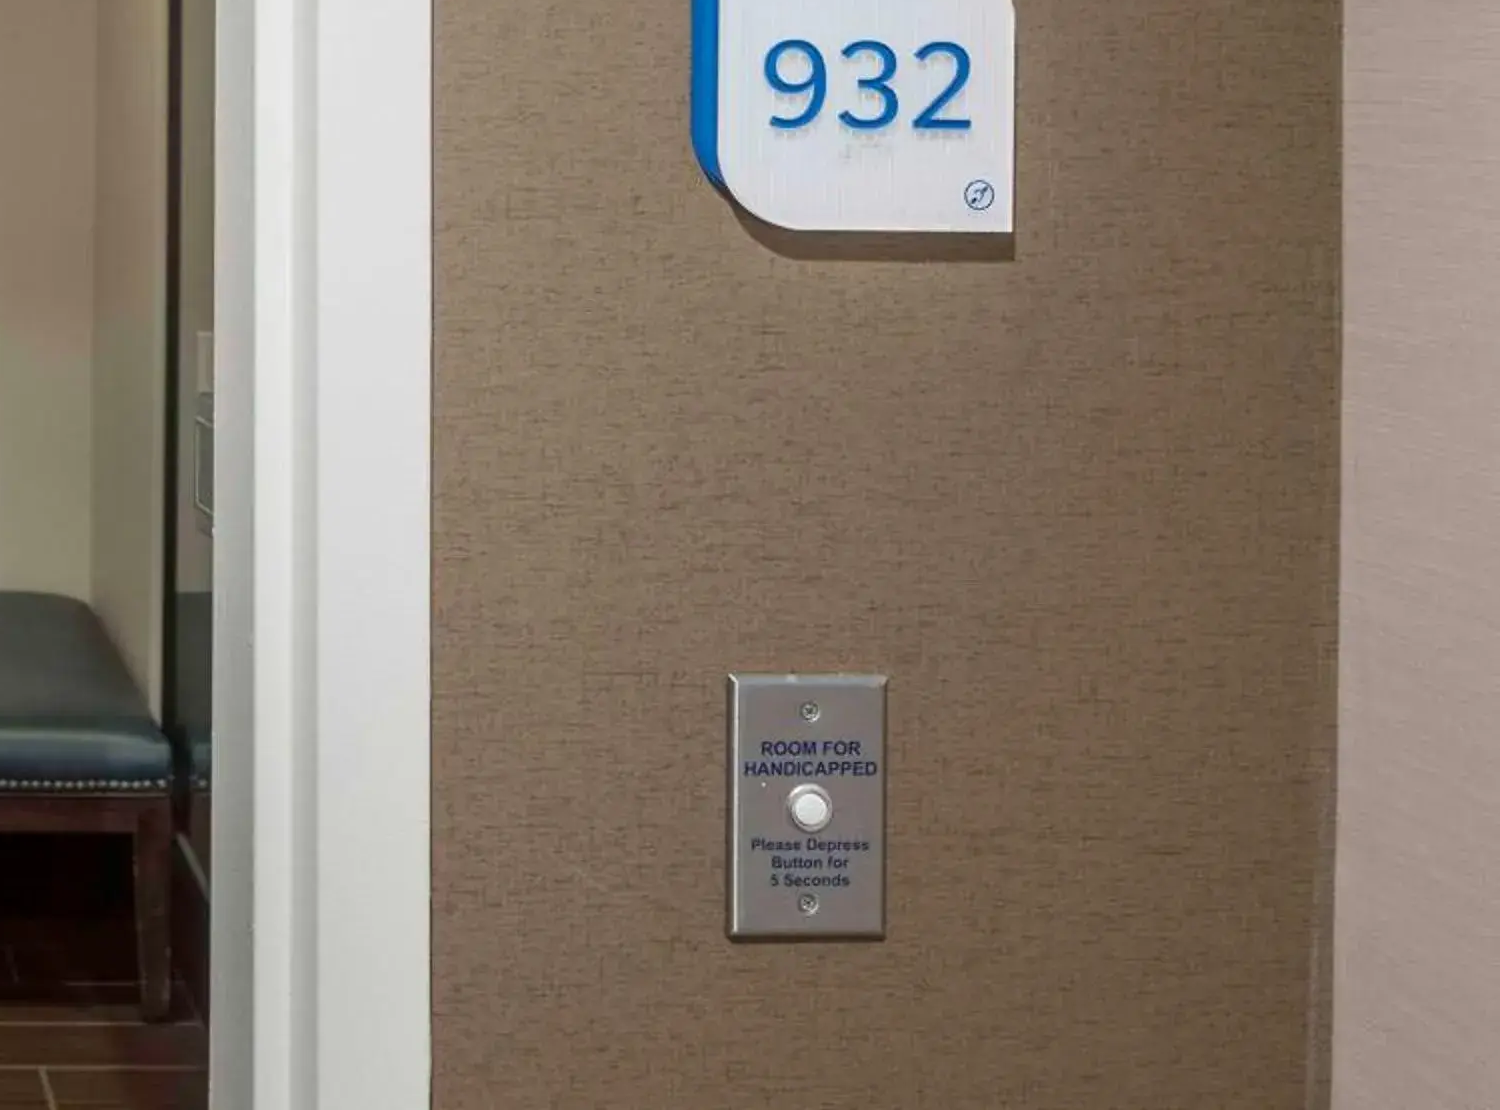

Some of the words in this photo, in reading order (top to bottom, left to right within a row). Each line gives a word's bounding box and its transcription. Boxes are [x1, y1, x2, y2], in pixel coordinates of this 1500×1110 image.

[763, 38, 972, 130] 932
[761, 741, 817, 756] ROOM
[822, 741, 861, 756] FOR
[744, 761, 877, 777] HANDICAPPED
[751, 839, 801, 851] Please
[806, 839, 870, 854] Depress
[771, 856, 823, 869] Button
[827, 856, 850, 869] for
[770, 874, 780, 887] 5
[784, 873, 851, 888] Seconds
